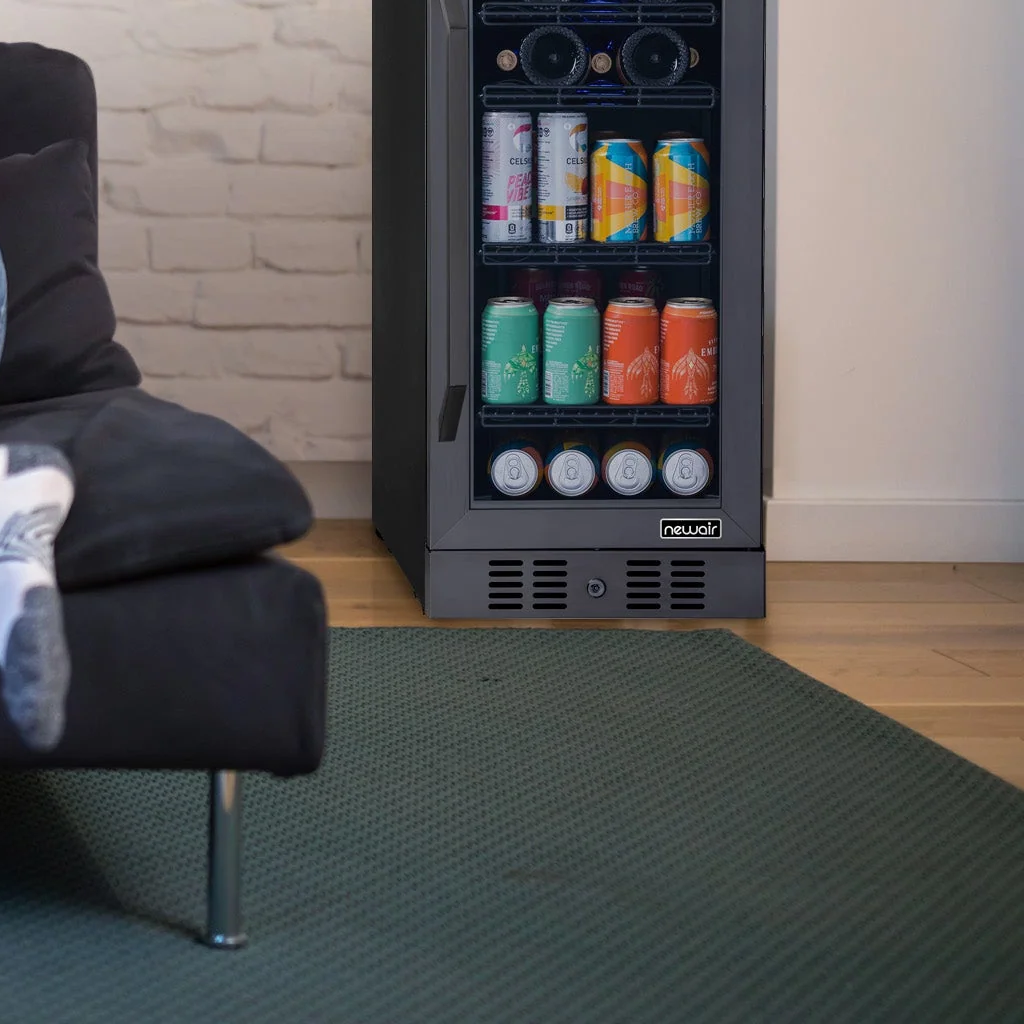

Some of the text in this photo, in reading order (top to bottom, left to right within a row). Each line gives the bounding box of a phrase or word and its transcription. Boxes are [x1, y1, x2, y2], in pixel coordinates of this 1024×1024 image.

[509, 157, 531, 166] CELS
[566, 157, 587, 165] CELS
[664, 522, 717, 535] newair
